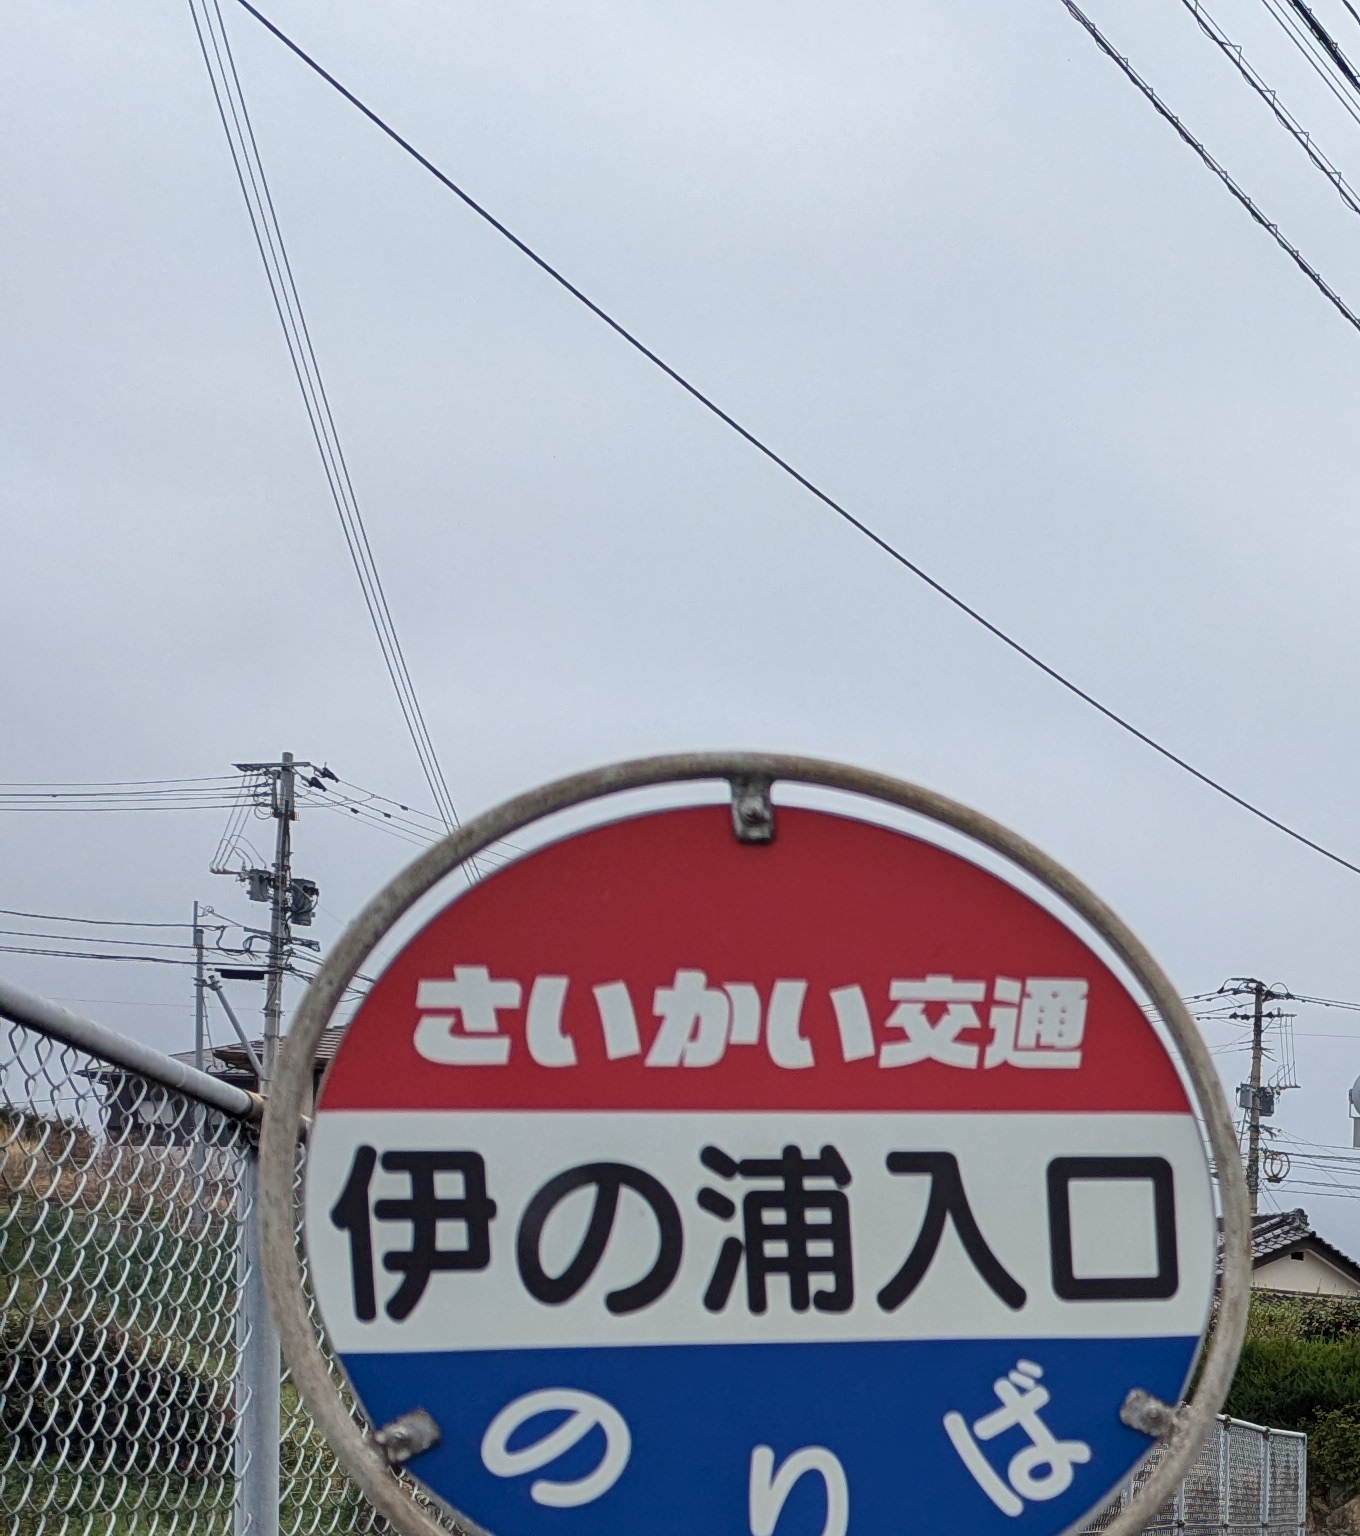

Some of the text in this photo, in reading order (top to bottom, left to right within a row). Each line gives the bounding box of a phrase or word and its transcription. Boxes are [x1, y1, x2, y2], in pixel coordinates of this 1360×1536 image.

[411, 965, 1090, 1070] さいかい交通
[331, 1143, 1180, 1322] 伊の浦入口
